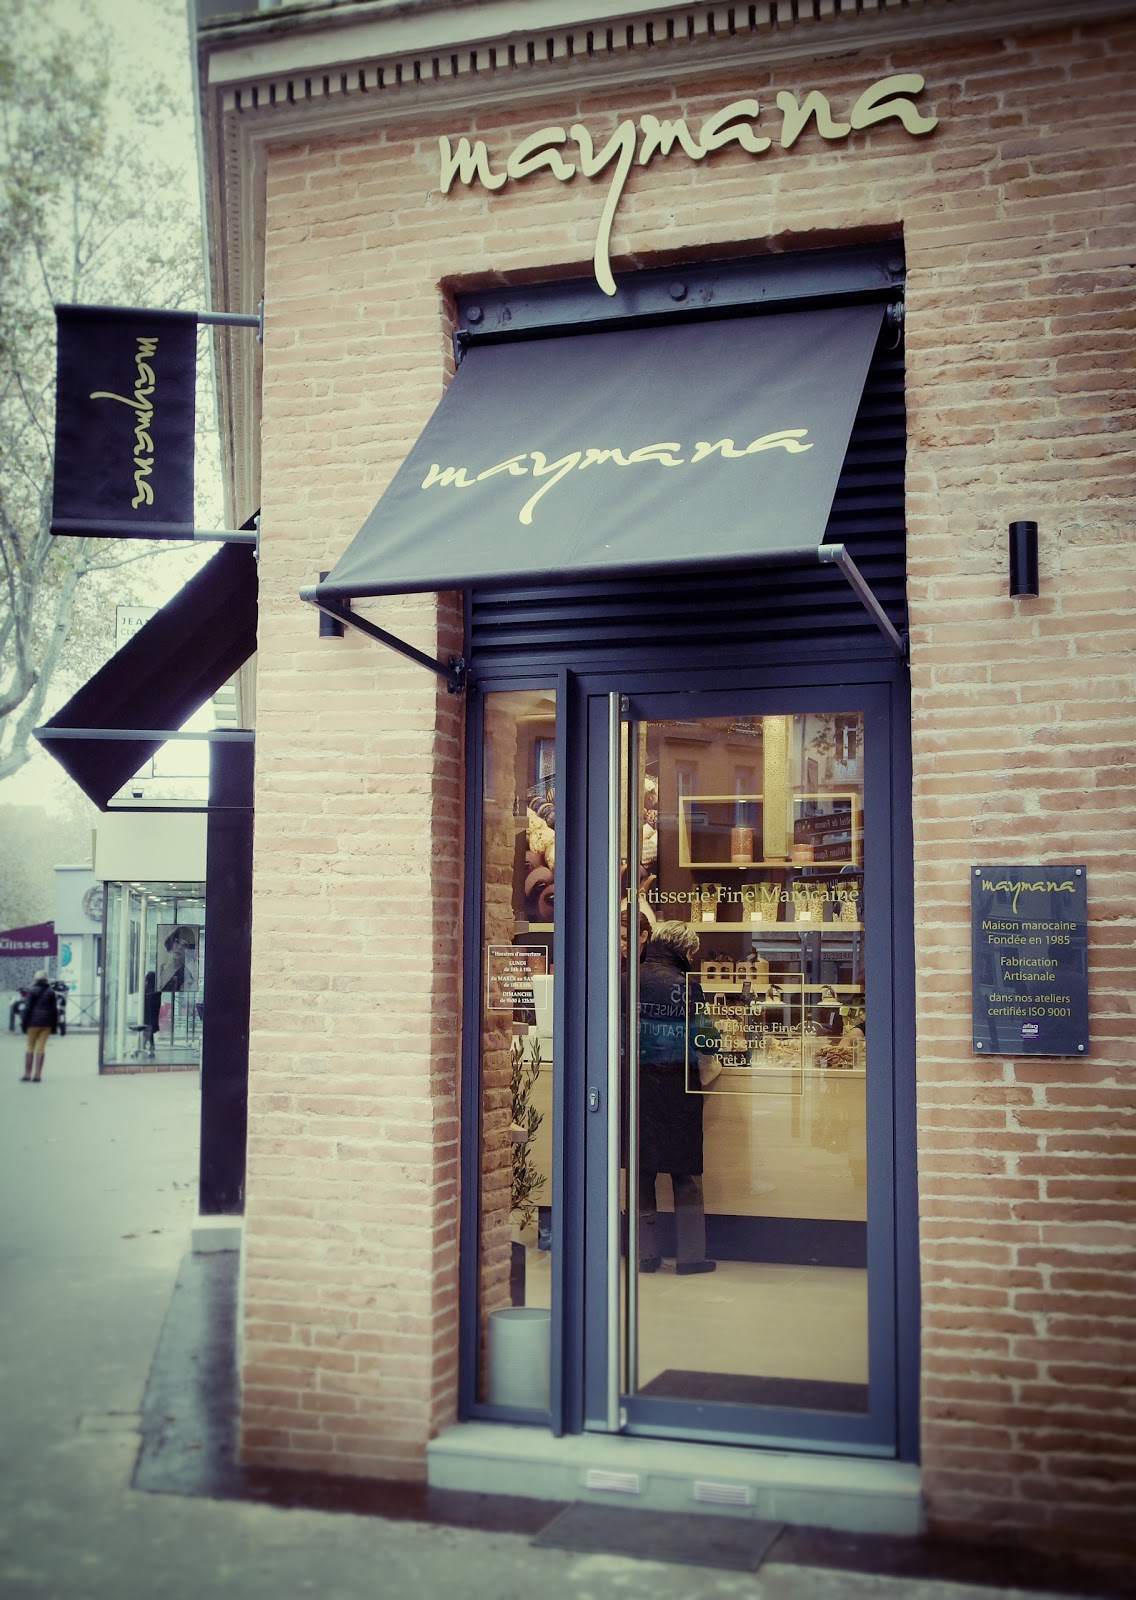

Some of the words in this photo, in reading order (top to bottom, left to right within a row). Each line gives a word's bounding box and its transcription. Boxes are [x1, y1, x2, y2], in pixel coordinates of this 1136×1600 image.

[438, 74, 939, 297] maymana
[89, 337, 159, 509] maymana
[421, 429, 814, 525] maymana
[120, 628, 138, 636] CLA
[717, 886, 755, 903] Fine
[759, 886, 860, 903] Marocaine
[982, 879, 1076, 914] maymana
[982, 920, 1019, 931] Maison
[1021, 920, 1077, 931] marocaine
[988, 934, 1027, 945] Fondée
[1028, 937, 1042, 945] en
[1045, 935, 1070, 945] 1985
[1000, 956, 1058, 967] Fabrication
[1003, 971, 1056, 981] Artisanale
[989, 992, 1013, 1002] dans
[1015, 994, 1033, 1003] nos
[1035, 993, 1070, 1003] ateliers
[987, 1006, 1027, 1016] certifiés
[1028, 1006, 1045, 1016] ISO
[1047, 1007, 1071, 1017] 9001
[772, 1022, 797, 1033] Fine
[694, 1034, 767, 1049] Confiserie
[715, 1053, 738, 1065] Prêt
[741, 1056, 747, 1065] à
